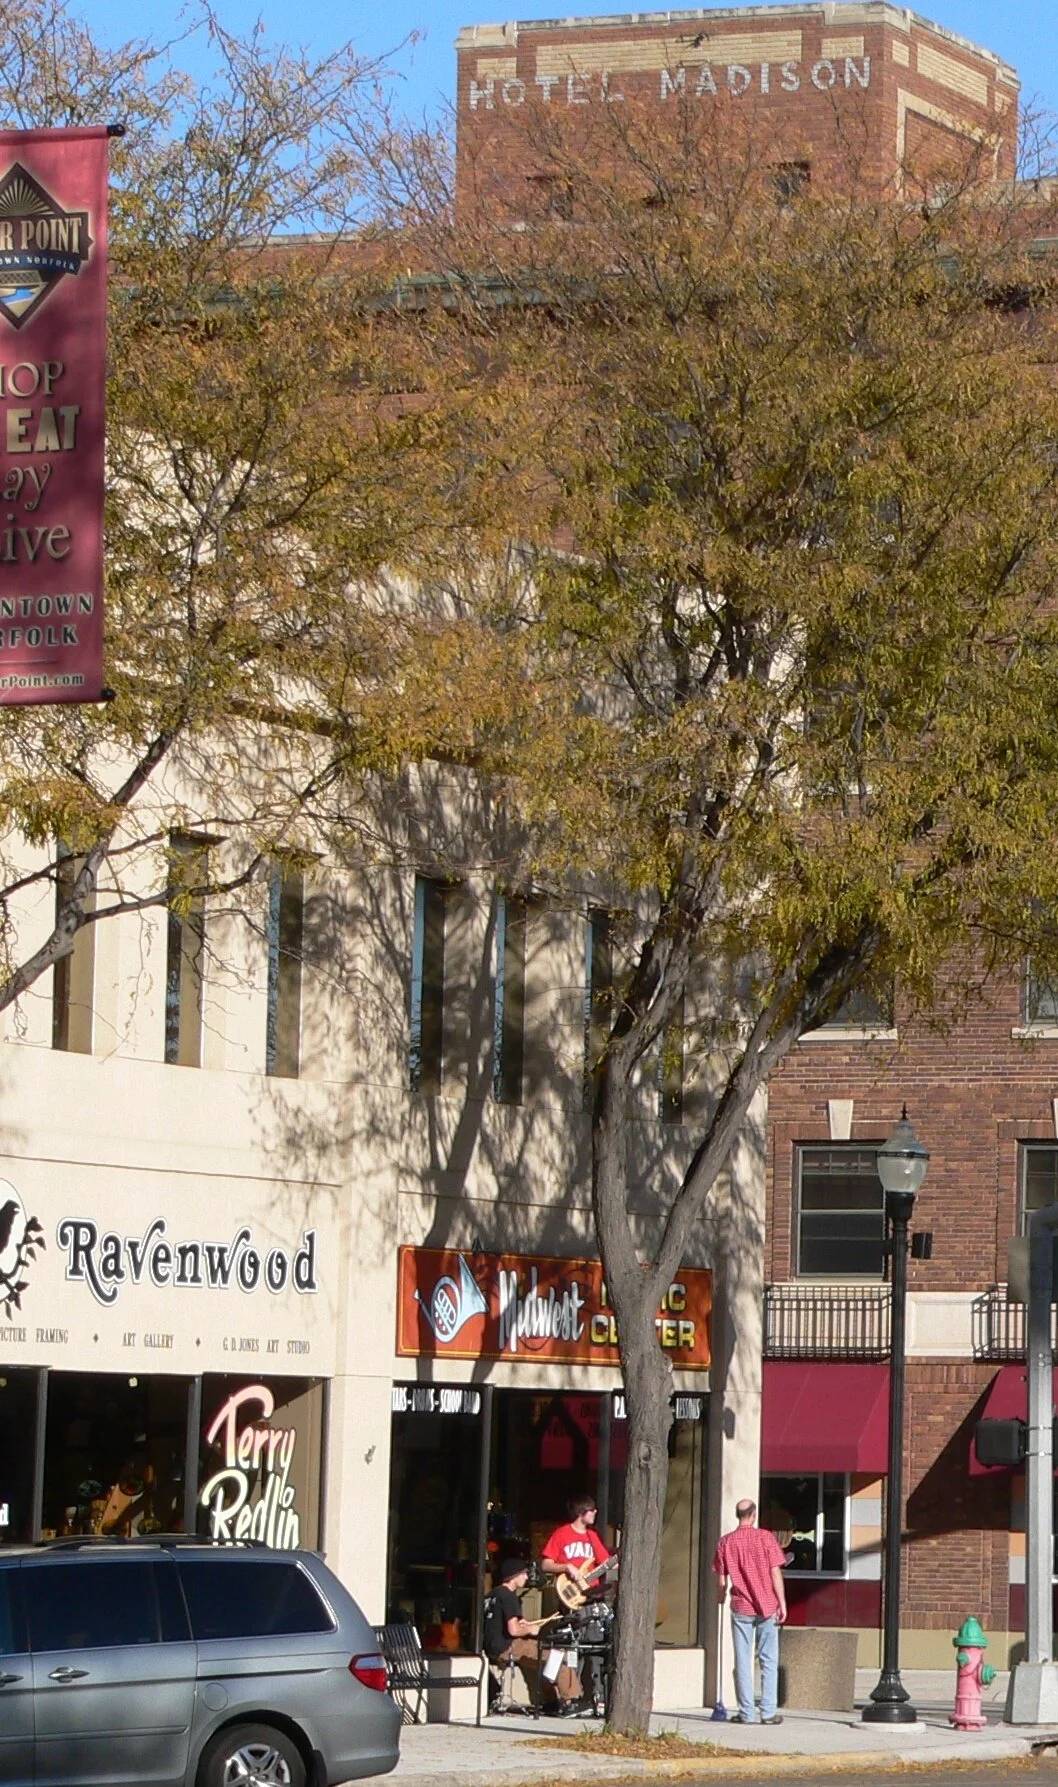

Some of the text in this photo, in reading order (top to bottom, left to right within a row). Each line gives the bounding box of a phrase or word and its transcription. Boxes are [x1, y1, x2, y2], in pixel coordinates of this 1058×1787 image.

[469, 56, 871, 111] HOTEL MADISON
[21, 217, 82, 254] POINT
[6, 404, 80, 452] EAT
[0, 624, 79, 650] FOLK
[57, 1217, 318, 1306] Ravenwood
[499, 1265, 585, 1352] Midwest
[35, 1328, 69, 1344] FRAMING
[122, 1332, 174, 1349] ART GALLERY
[266, 1339, 280, 1353] ART
[591, 1314, 695, 1348] CEER
[207, 1385, 296, 1508] Terry
[201, 1468, 301, 1550] Redlin
